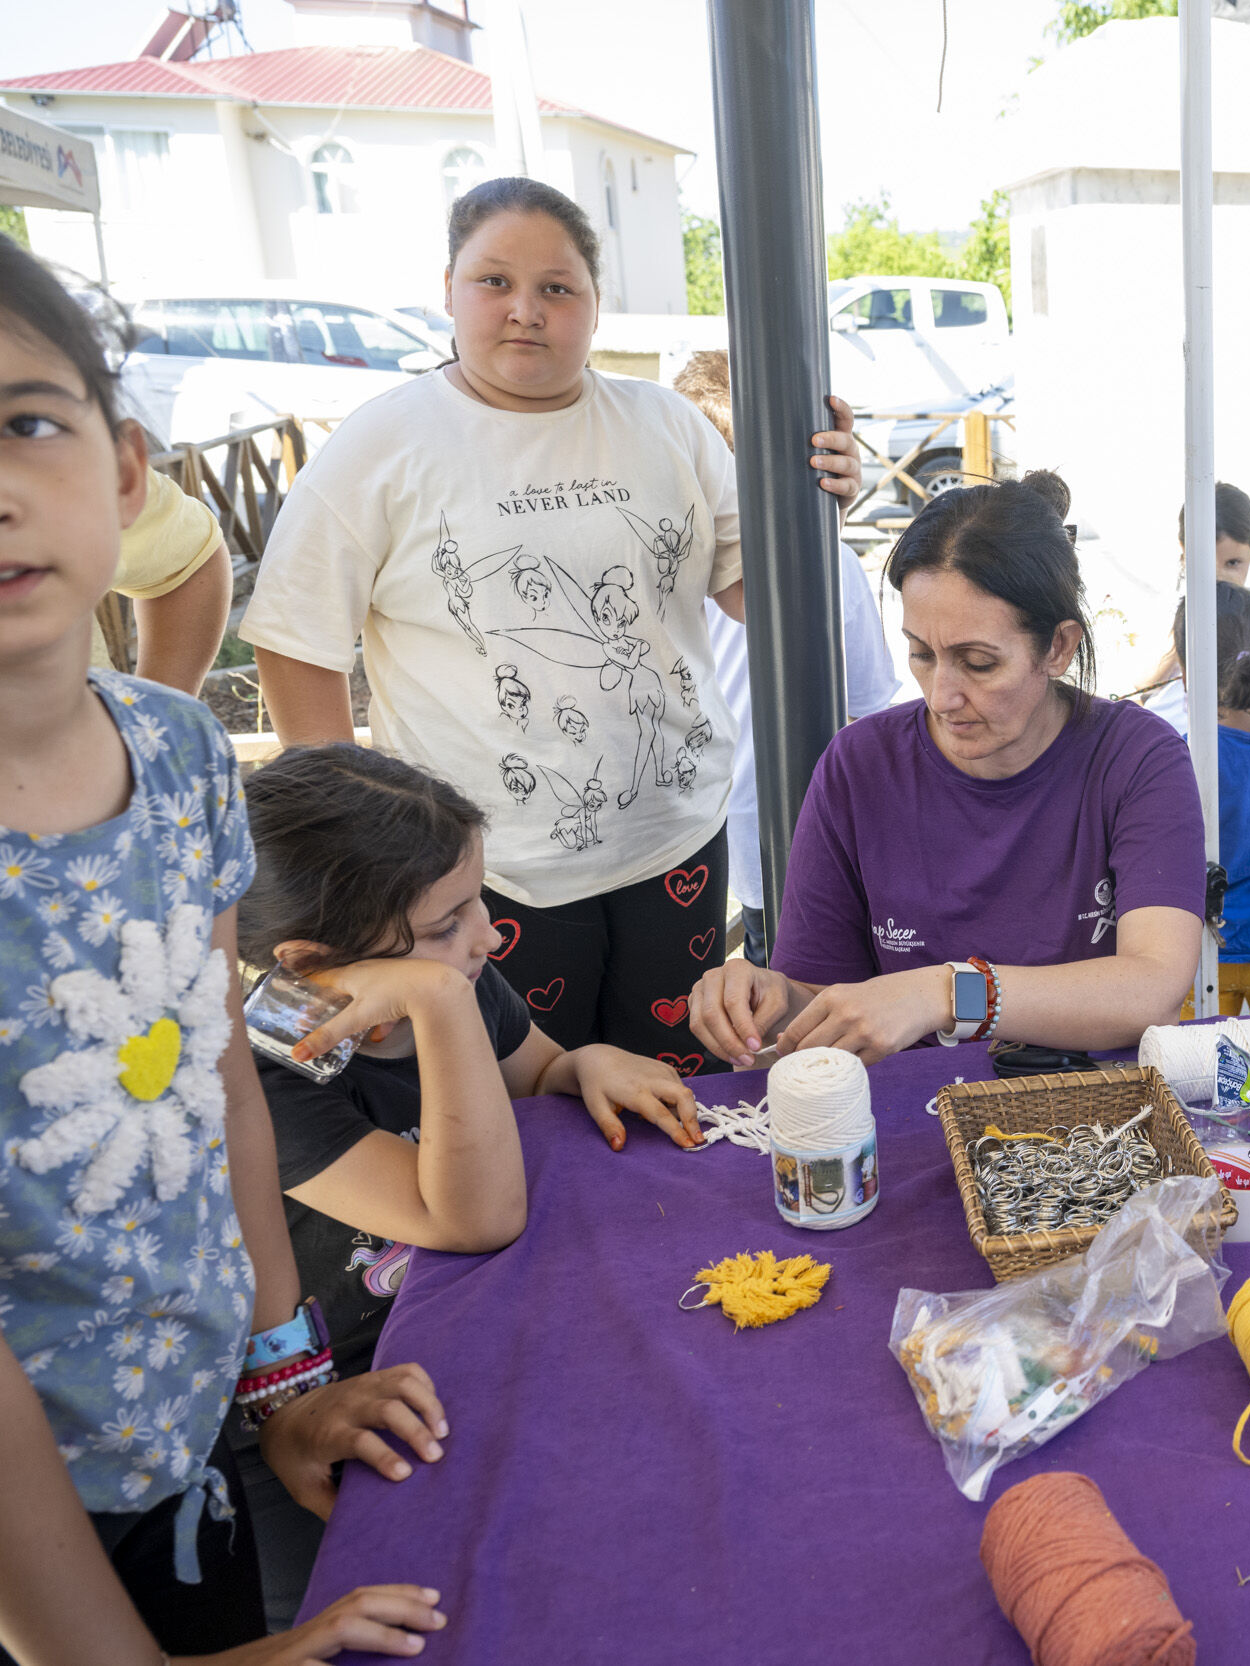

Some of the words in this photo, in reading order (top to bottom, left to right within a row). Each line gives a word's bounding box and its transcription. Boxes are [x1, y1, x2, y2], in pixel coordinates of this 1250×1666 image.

[522, 483, 553, 496] love
[554, 481, 565, 494] to
[496, 495, 569, 517] NEVER
[575, 487, 631, 508] LAND
[675, 879, 700, 896] love
[886, 918, 917, 941] Seçer
